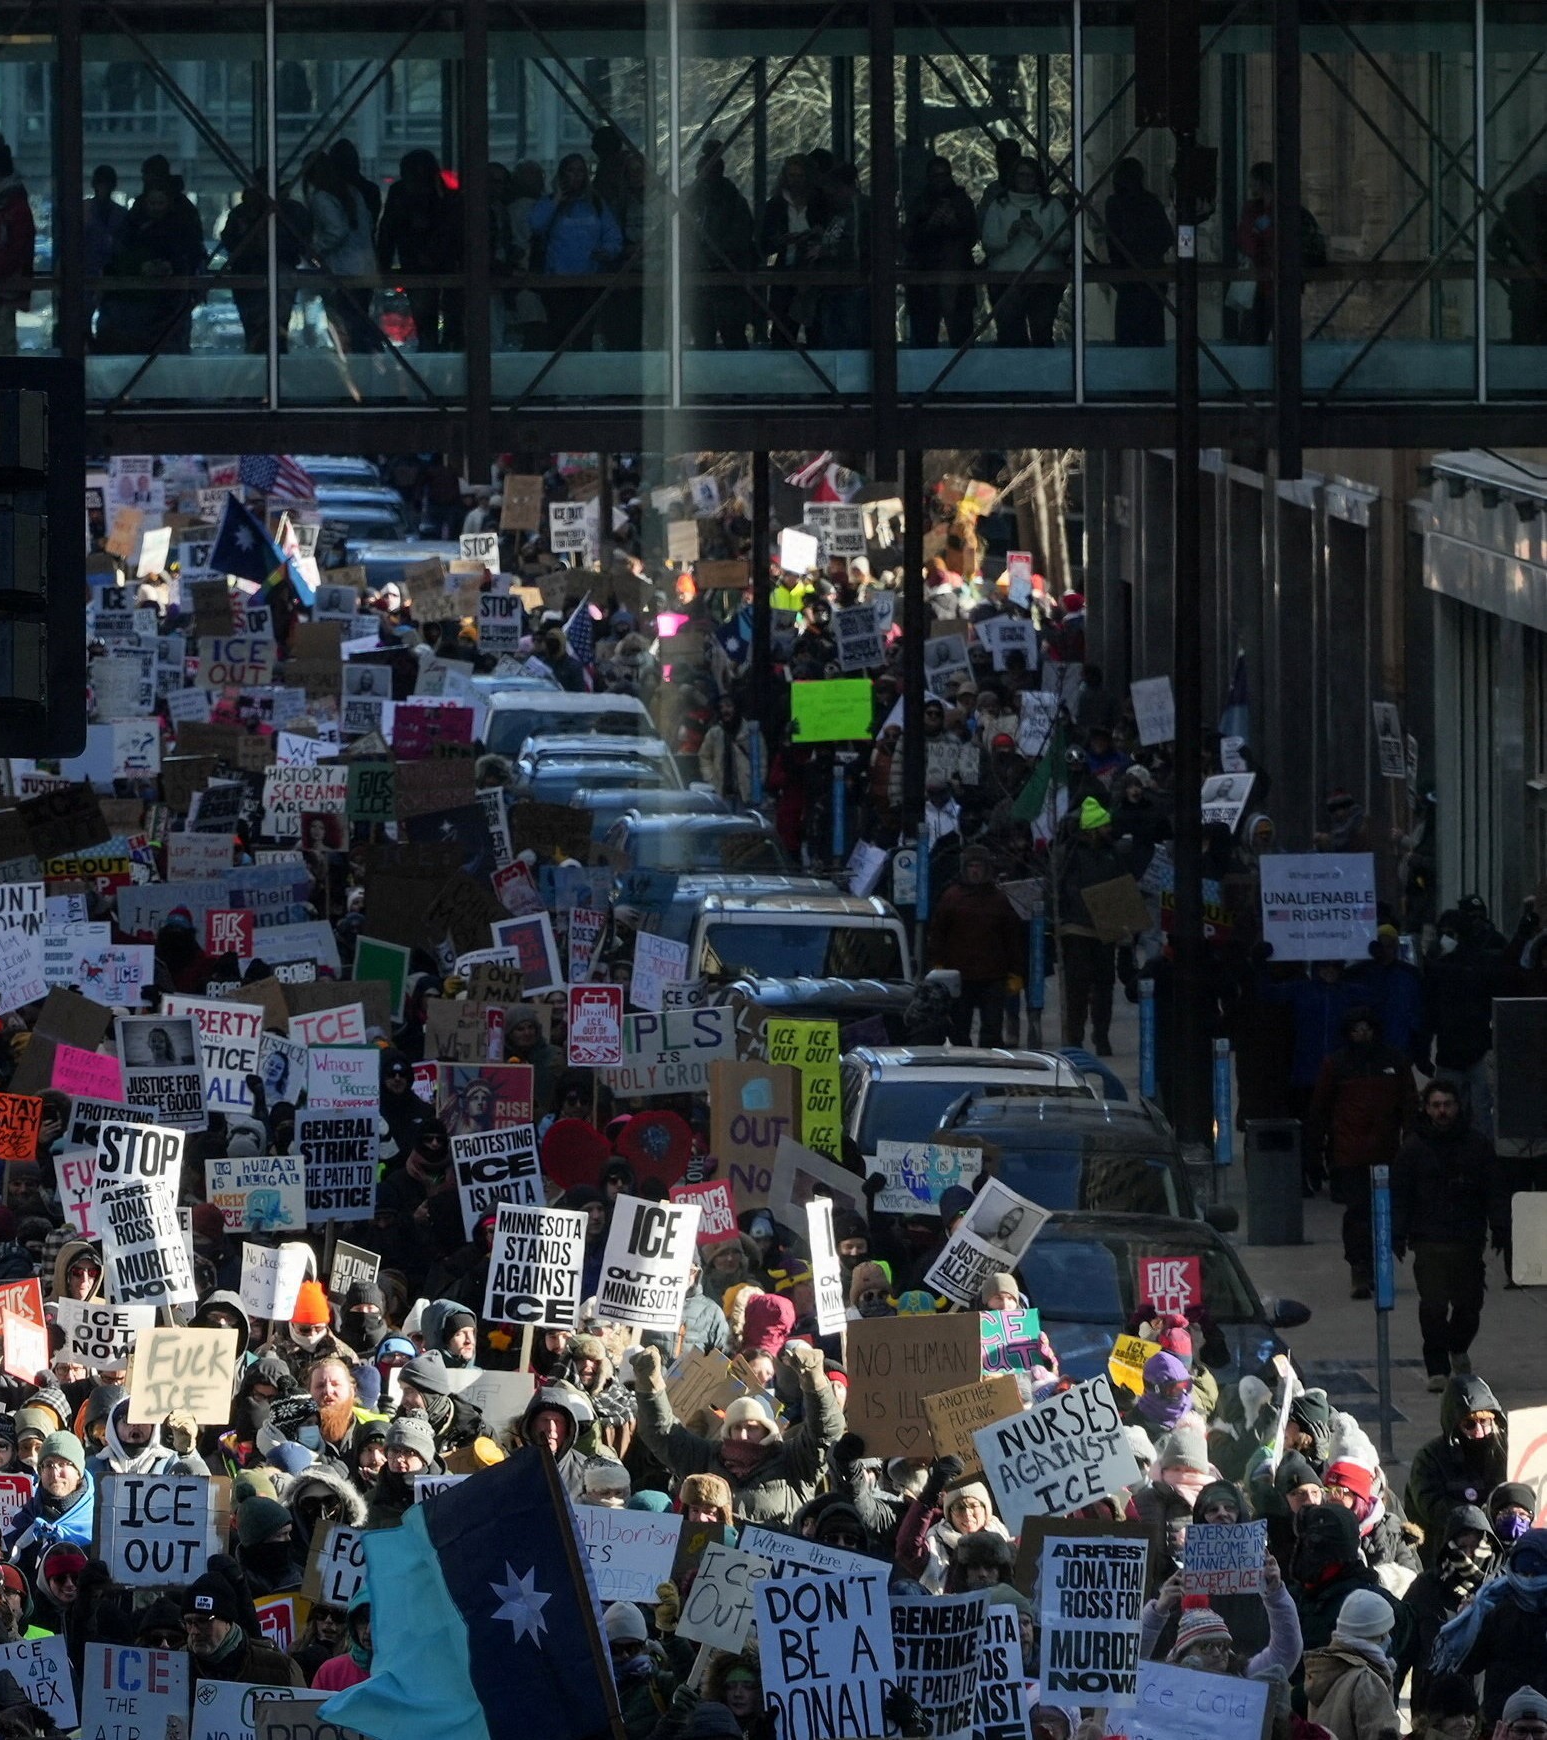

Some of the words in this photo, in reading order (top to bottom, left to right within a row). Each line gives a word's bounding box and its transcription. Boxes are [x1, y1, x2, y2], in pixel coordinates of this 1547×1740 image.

[1264, 891, 1374, 905] UNALIENABLE
[212, 937, 244, 956] ICE
[295, 1010, 359, 1043] ICE
[773, 1029, 795, 1044] ICE
[807, 1030, 829, 1045] ICE
[771, 1046, 798, 1062] OUT
[805, 1047, 832, 1062] OUT
[731, 1117, 788, 1147] OUT
[99, 1125, 176, 1177] STOP
[498, 1211, 581, 1238] MINNESOTA
[628, 1203, 683, 1259] ICE
[504, 1237, 570, 1265] STANDS
[493, 1264, 578, 1296] AGAINST
[607, 1265, 658, 1283] OUT
[1147, 1260, 1188, 1290] FUCK
[490, 1295, 574, 1324] ICE
[603, 1280, 678, 1310] MINNESOTA
[1153, 1290, 1190, 1314] ICE
[83, 1310, 129, 1326] ICE
[75, 1326, 134, 1342] OUT
[145, 1382, 219, 1416] ICE
[998, 1378, 1118, 1457] NURSES
[999, 1432, 1121, 1493] AGAINST
[121, 1480, 197, 1527] ICE
[1034, 1463, 1106, 1516] ICE
[125, 1540, 200, 1572] OUT
[1185, 1541, 1248, 1555] WELCOME
[766, 1576, 876, 1623] DON'T
[780, 1627, 828, 1684] BE
[852, 1631, 878, 1672] A
